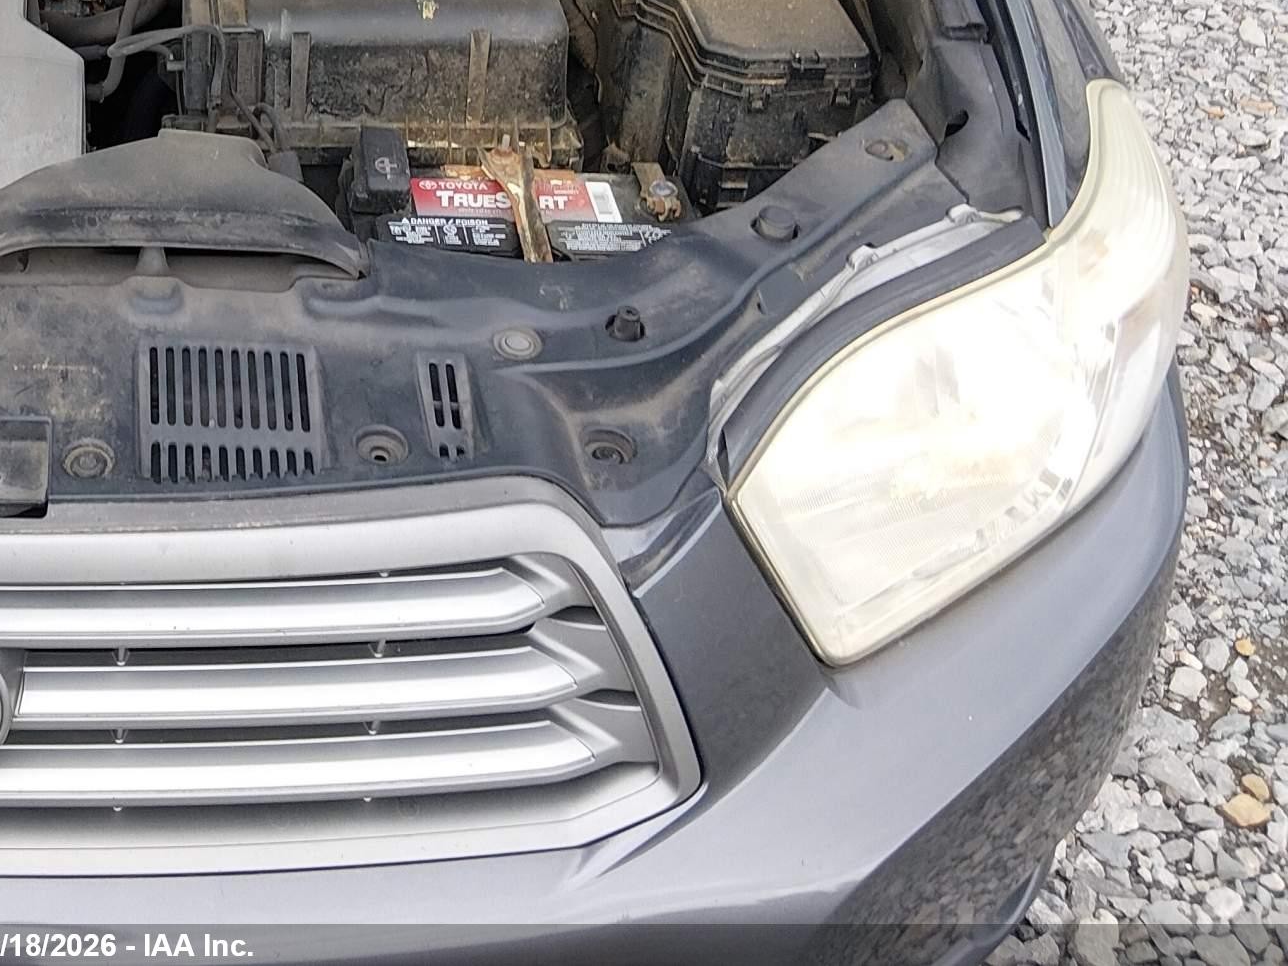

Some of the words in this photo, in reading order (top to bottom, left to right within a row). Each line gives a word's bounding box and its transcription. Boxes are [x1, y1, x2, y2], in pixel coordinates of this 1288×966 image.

[437, 182, 488, 191] TOYOTA
[435, 189, 569, 211] TRUESRT
[410, 217, 447, 226] DANGER
[455, 218, 489, 227] POISON
